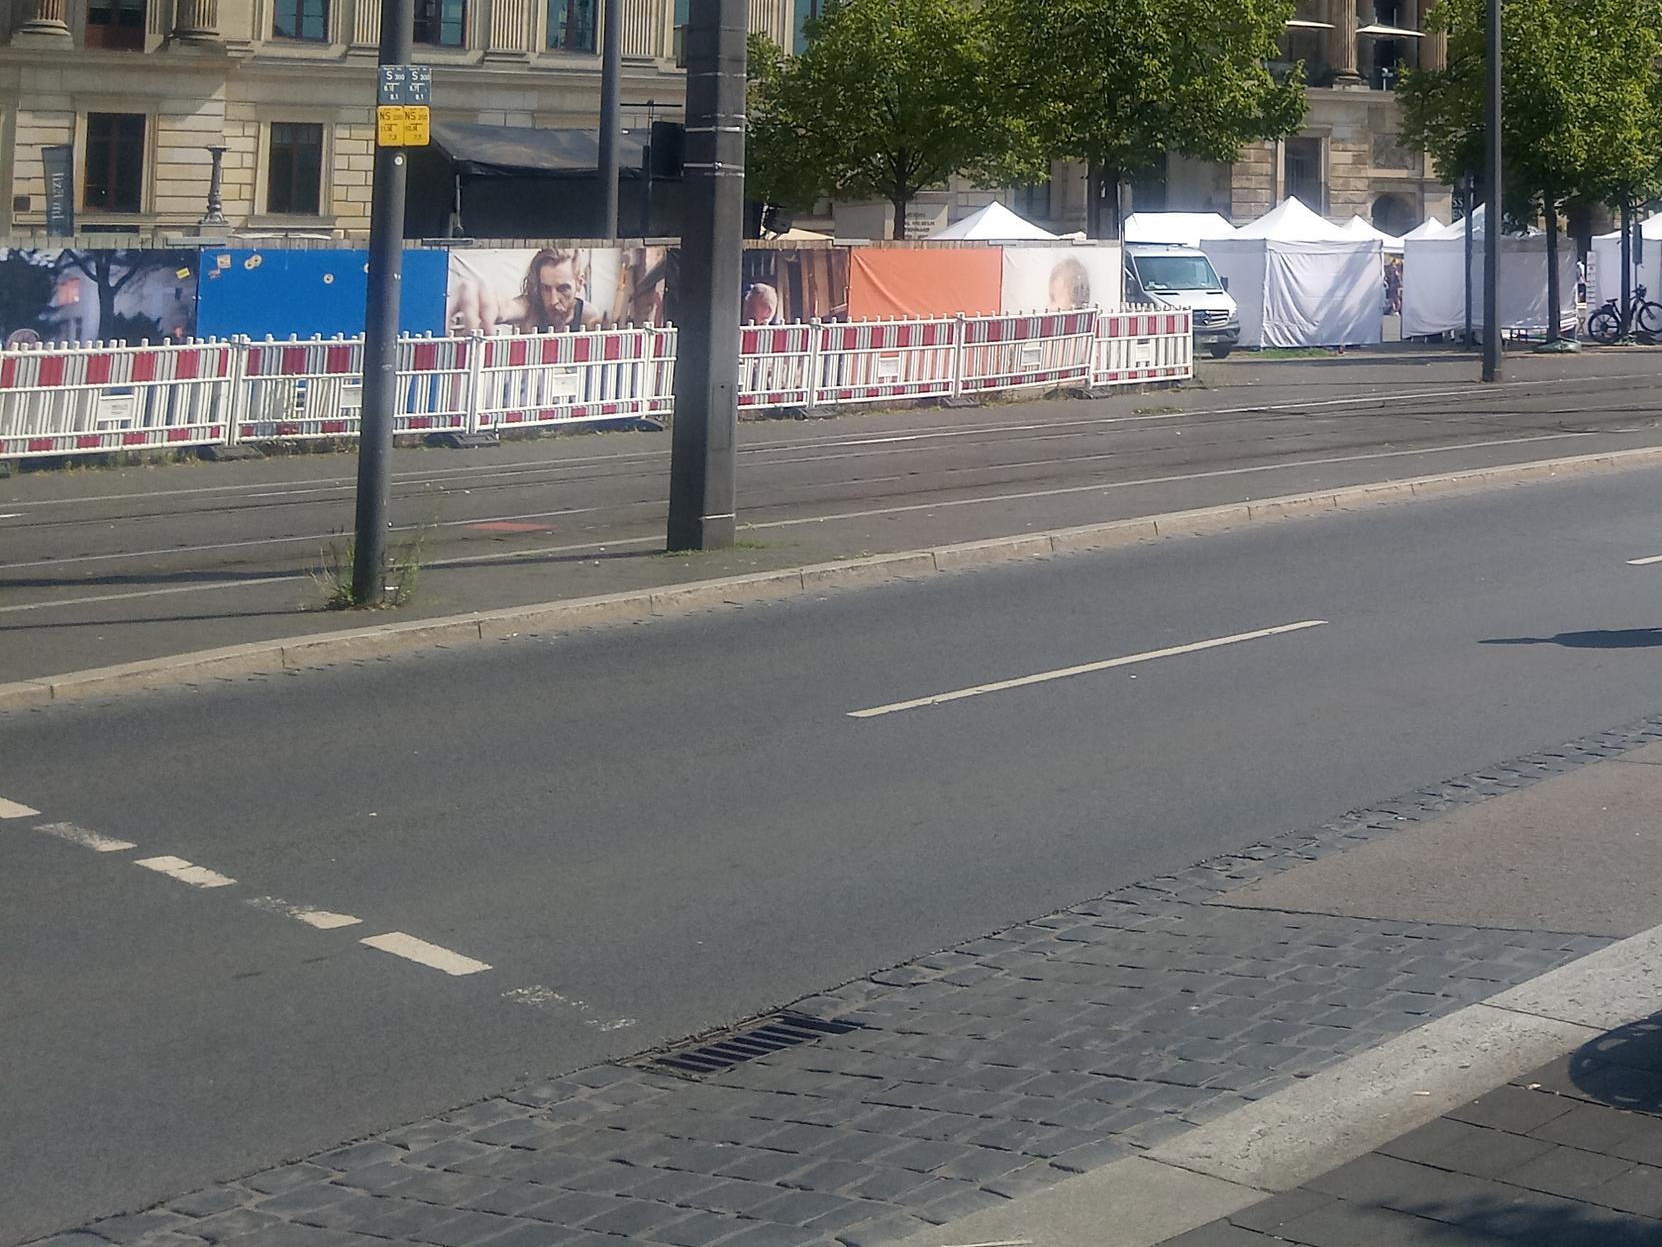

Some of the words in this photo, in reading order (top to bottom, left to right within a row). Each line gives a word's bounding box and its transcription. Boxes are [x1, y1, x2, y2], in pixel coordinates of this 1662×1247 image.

[386, 71, 393, 81] S
[412, 71, 419, 81] S
[380, 111, 391, 121] NS
[404, 111, 416, 121] NS
